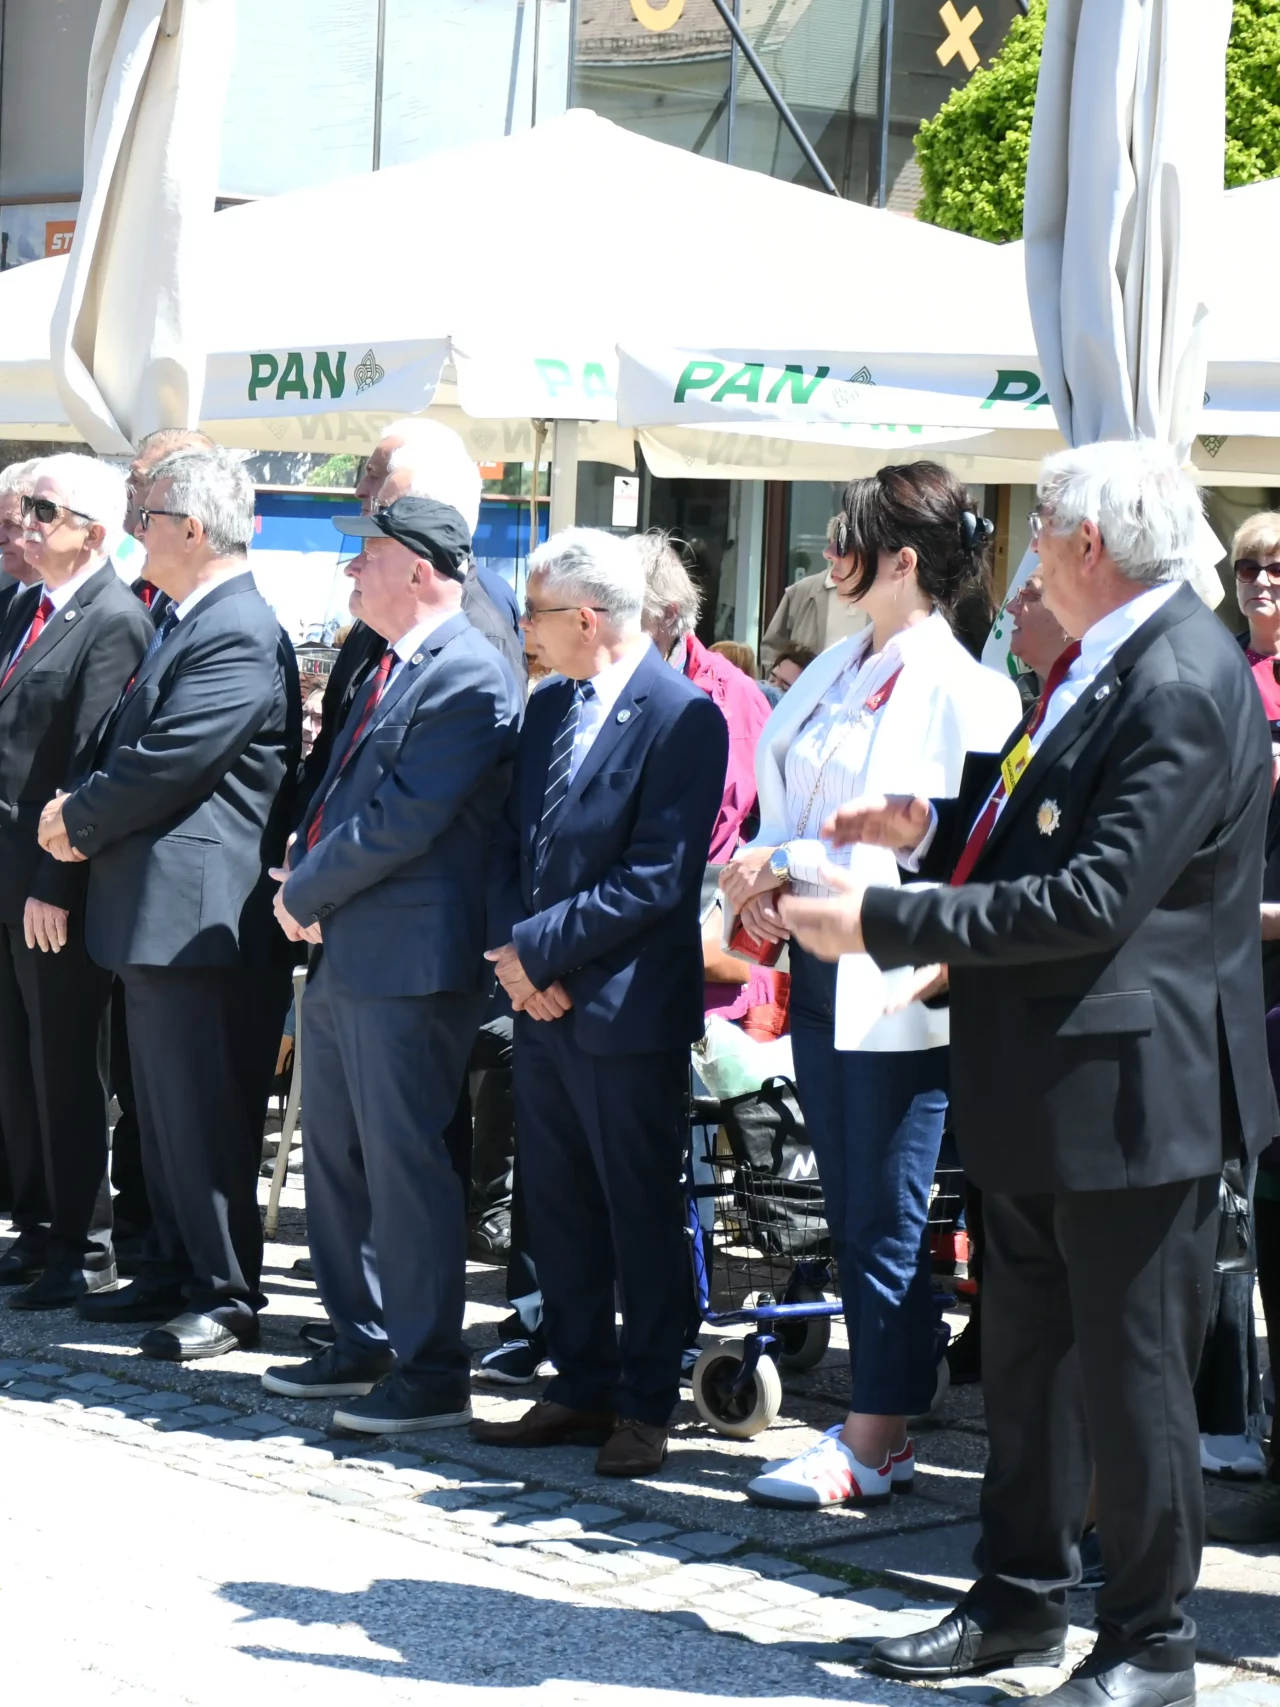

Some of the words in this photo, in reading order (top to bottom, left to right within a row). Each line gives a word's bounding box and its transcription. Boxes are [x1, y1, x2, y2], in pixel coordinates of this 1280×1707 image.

[51, 232, 75, 250] ST
[248, 351, 347, 401] PAN
[534, 357, 617, 399] PA
[673, 360, 830, 404] PAN
